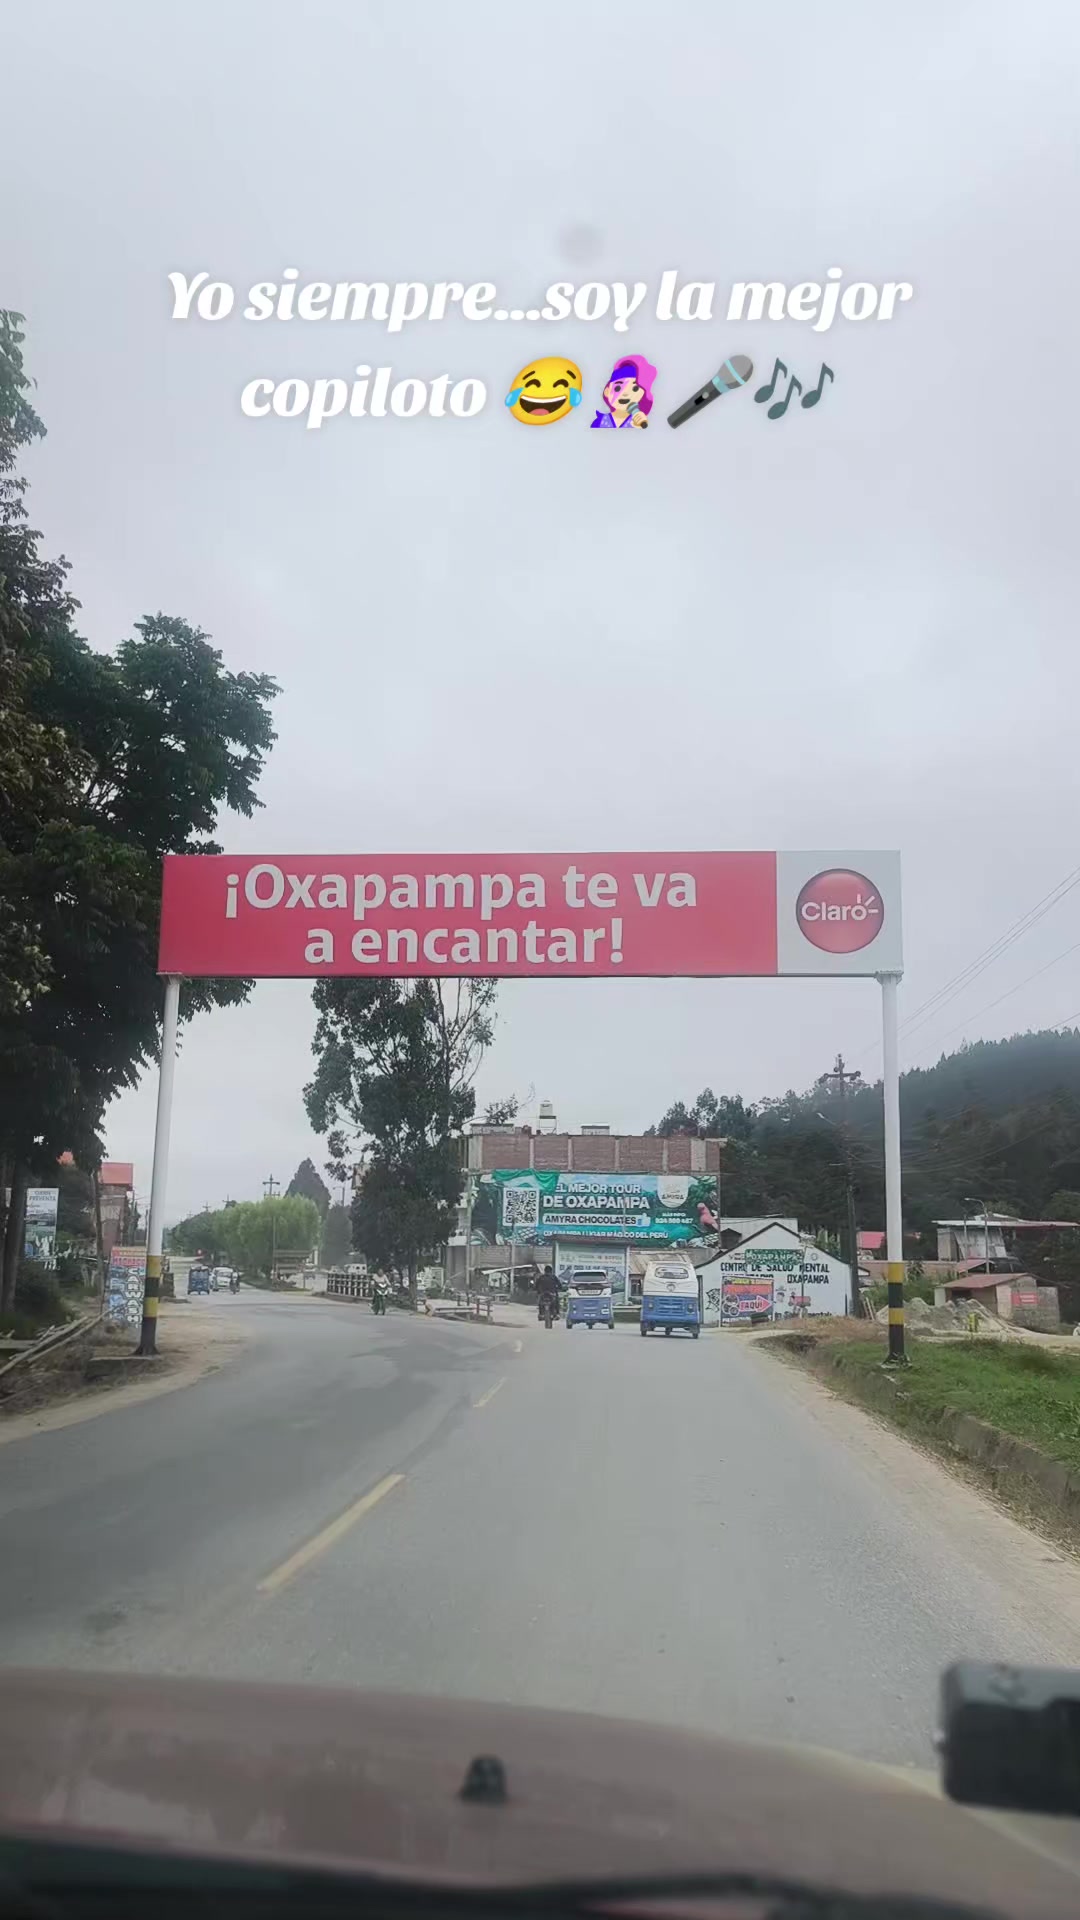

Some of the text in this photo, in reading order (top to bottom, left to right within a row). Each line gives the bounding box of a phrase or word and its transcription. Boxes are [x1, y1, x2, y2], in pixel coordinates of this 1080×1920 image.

[225, 863, 697, 921] ¡Oxapampa te va
[801, 897, 873, 921] Claro
[304, 917, 624, 964] a encantar!
[568, 1184, 607, 1193] MEJOR
[610, 1184, 641, 1194] TOUR
[543, 1195, 650, 1209] DE OXAPAMPA
[545, 1215, 637, 1225] AMYRA CHOCOLATES
[649, 1231, 668, 1239] PERÚ
[721, 1262, 748, 1272] CENTRO
[751, 1264, 762, 1272] DE
[766, 1264, 794, 1272] SALUD
[787, 1274, 829, 1284] OXAPAMPA
